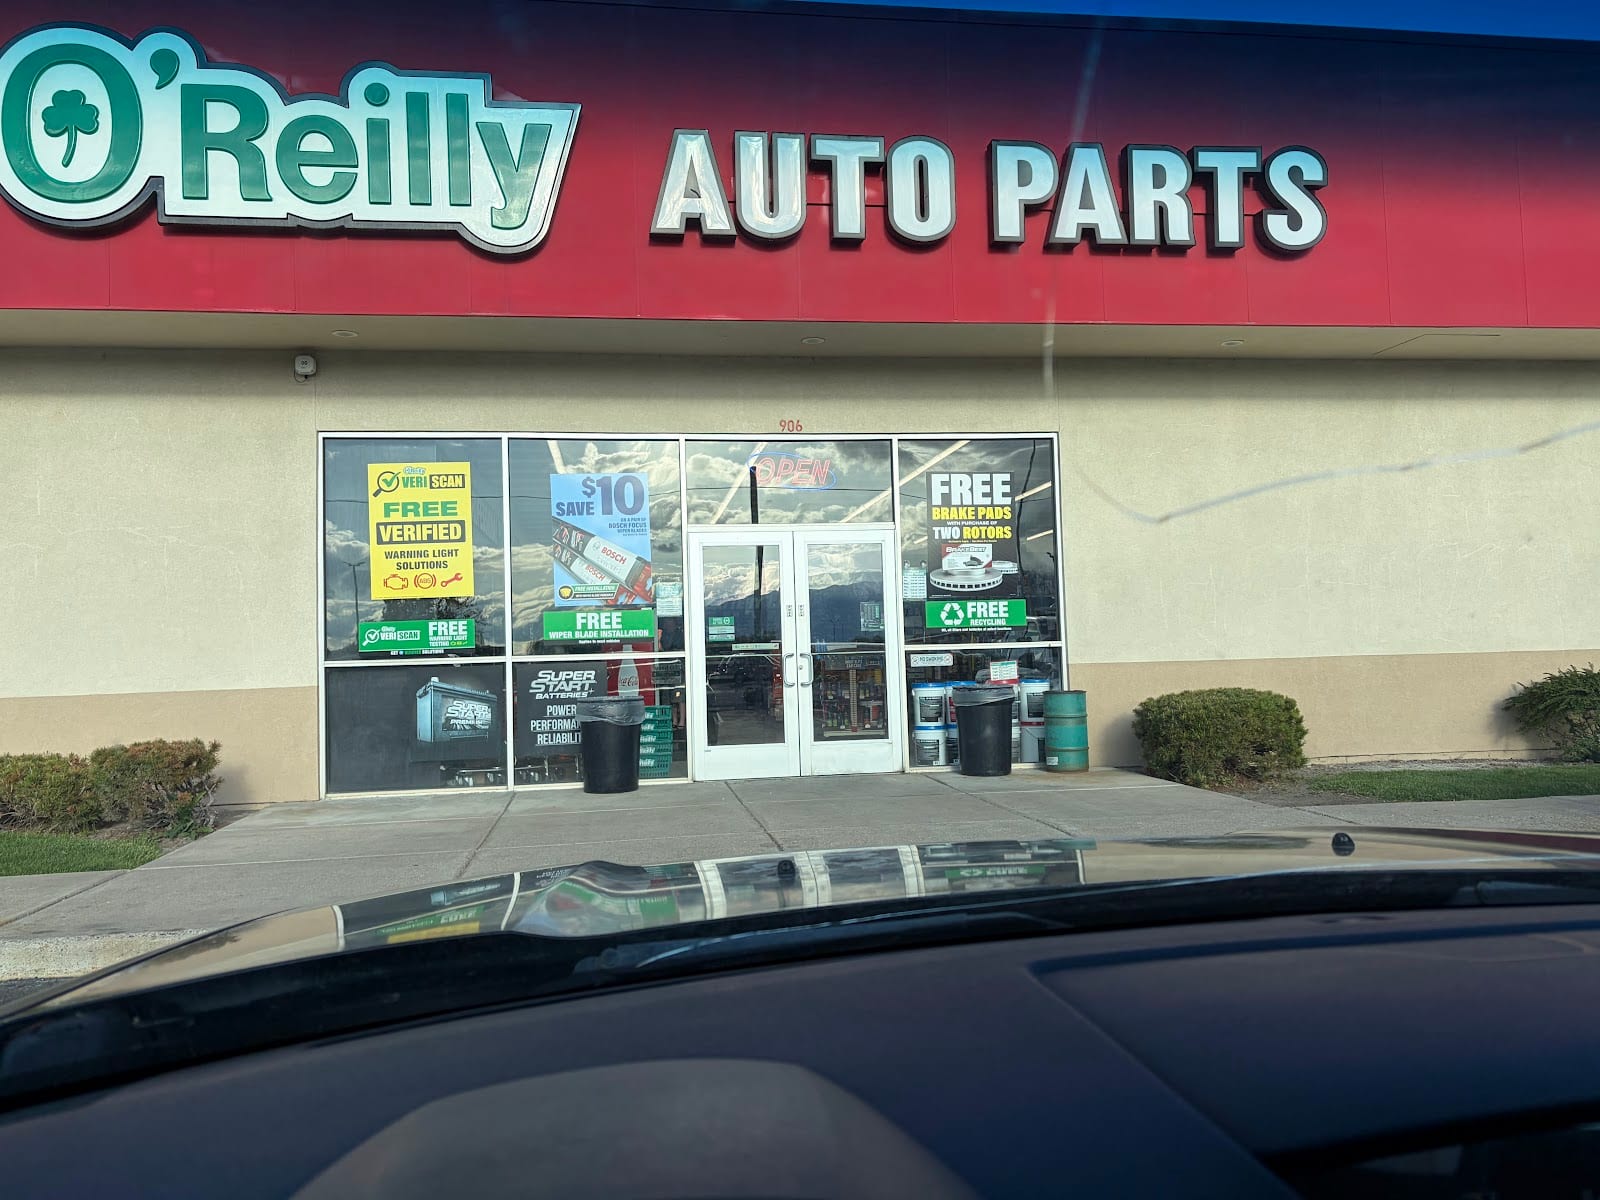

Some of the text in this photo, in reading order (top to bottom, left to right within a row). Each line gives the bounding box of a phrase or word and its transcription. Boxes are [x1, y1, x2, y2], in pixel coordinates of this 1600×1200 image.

[2, 41, 552, 230] O'Reilly
[650, 129, 1328, 254] AUTO PARTS
[779, 419, 803, 432] 906
[755, 457, 831, 485] OPEN
[401, 475, 463, 488] VERI SCAN
[555, 475, 645, 517] SAVE $10
[931, 473, 1012, 506] FREE
[383, 500, 458, 518] FREE
[931, 506, 1012, 520] BRAKE PADS
[378, 523, 462, 542] VERIFIED
[932, 525, 1012, 540] TWO ROTORS
[384, 548, 459, 559] WARNING LIGHT
[600, 546, 627, 565] BOSCH
[396, 560, 449, 571] SOLUTIONS
[585, 564, 606, 582] BOSCH
[966, 601, 1009, 619] FREE
[575, 611, 623, 630] FREE
[970, 618, 1006, 626] RECYCLING
[428, 620, 468, 636] FREE
[548, 629, 649, 639] WIPER BLADE INSTALLATION
[380, 631, 418, 640] VERI SCAN
[537, 670, 596, 681] SUPER
[529, 679, 597, 693] START
[446, 706, 490, 720] START
[453, 700, 489, 712] SUPER
[546, 704, 577, 716] POWER
[537, 732, 582, 745] RELIABILIT
